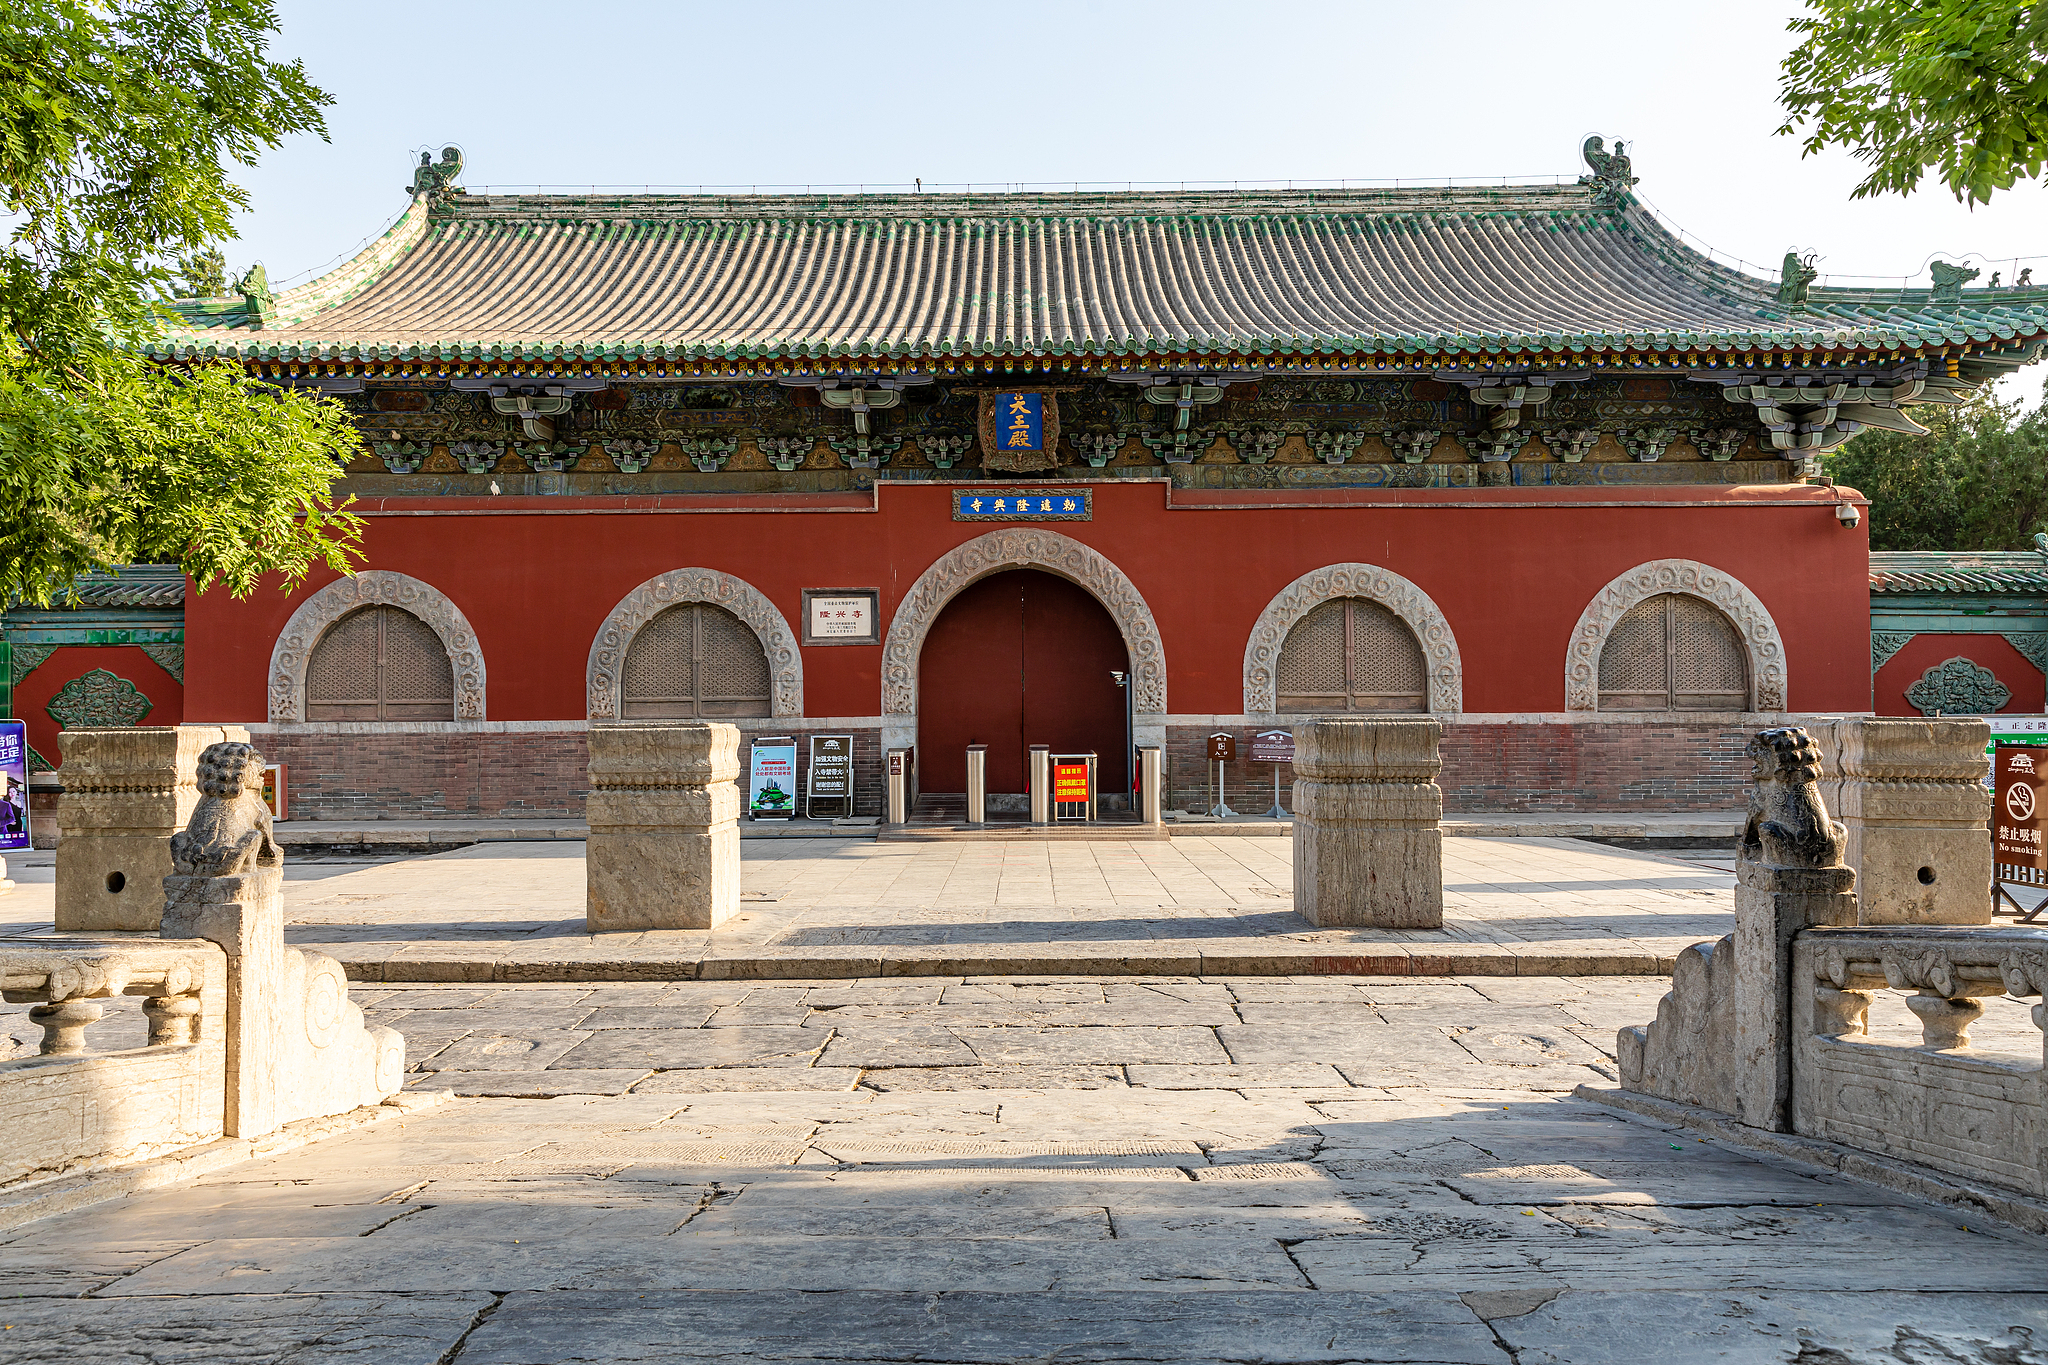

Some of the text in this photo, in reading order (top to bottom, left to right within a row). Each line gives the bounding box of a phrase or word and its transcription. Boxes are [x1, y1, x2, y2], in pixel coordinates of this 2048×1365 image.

[1007, 394, 1032, 448] 天王殿
[819, 610, 863, 619] 隆兴寺
[1998, 825, 2042, 844] 禁止吸烟
[1999, 842, 2043, 858] No smoking
